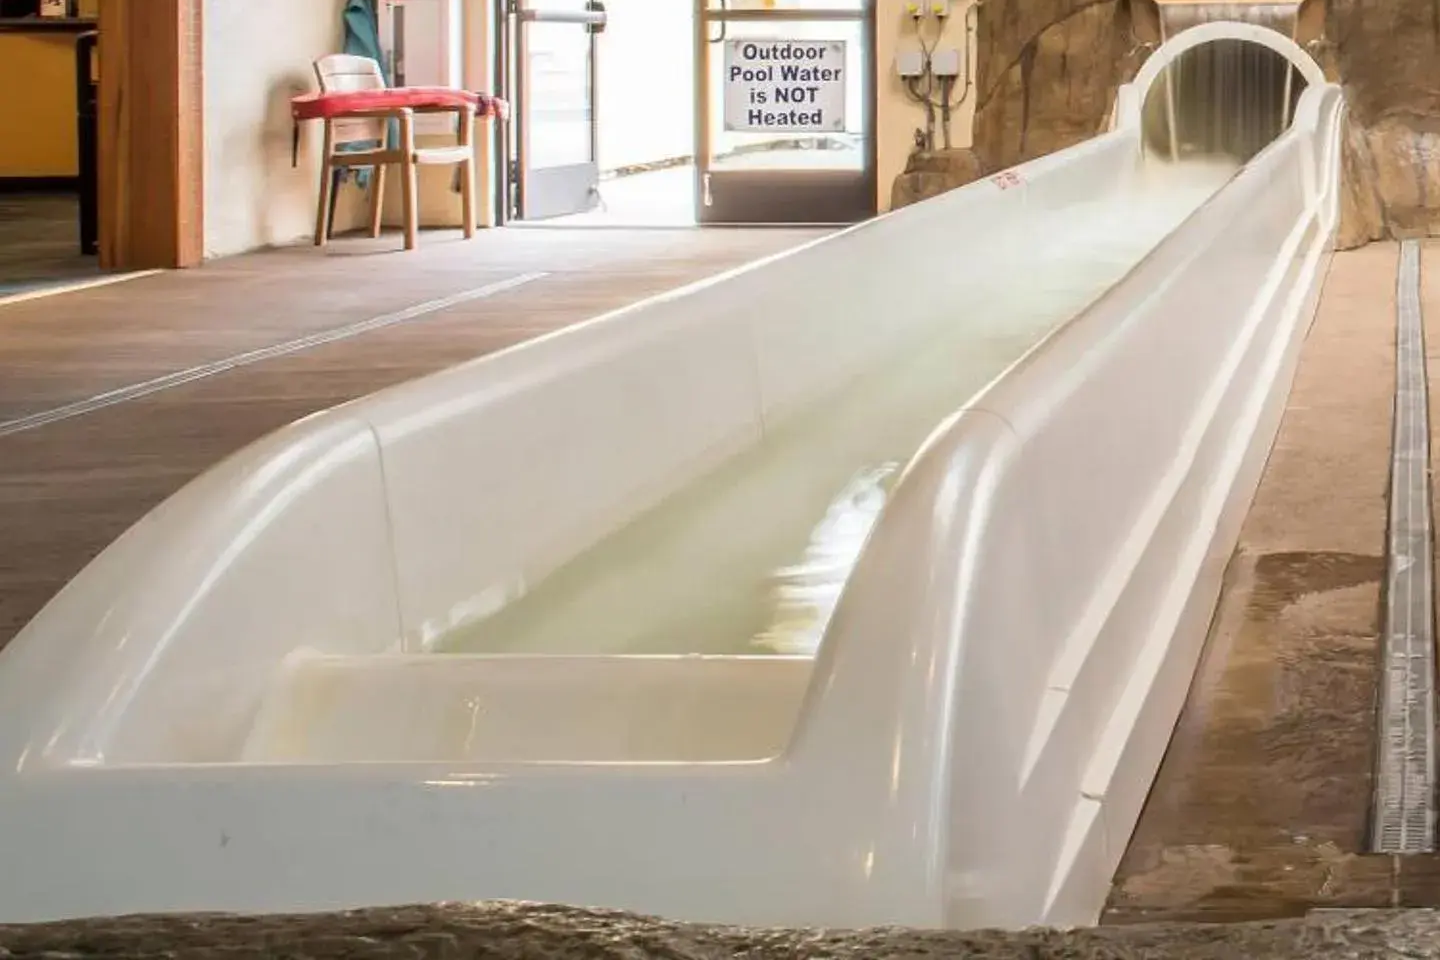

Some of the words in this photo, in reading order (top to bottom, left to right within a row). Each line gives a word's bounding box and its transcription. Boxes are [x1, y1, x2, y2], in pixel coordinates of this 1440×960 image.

[743, 43, 827, 61] Outdoor
[730, 66, 773, 82] Pool
[780, 66, 842, 82] Water
[750, 88, 768, 104] is
[774, 87, 819, 103] NOT
[748, 109, 823, 126] Heated
